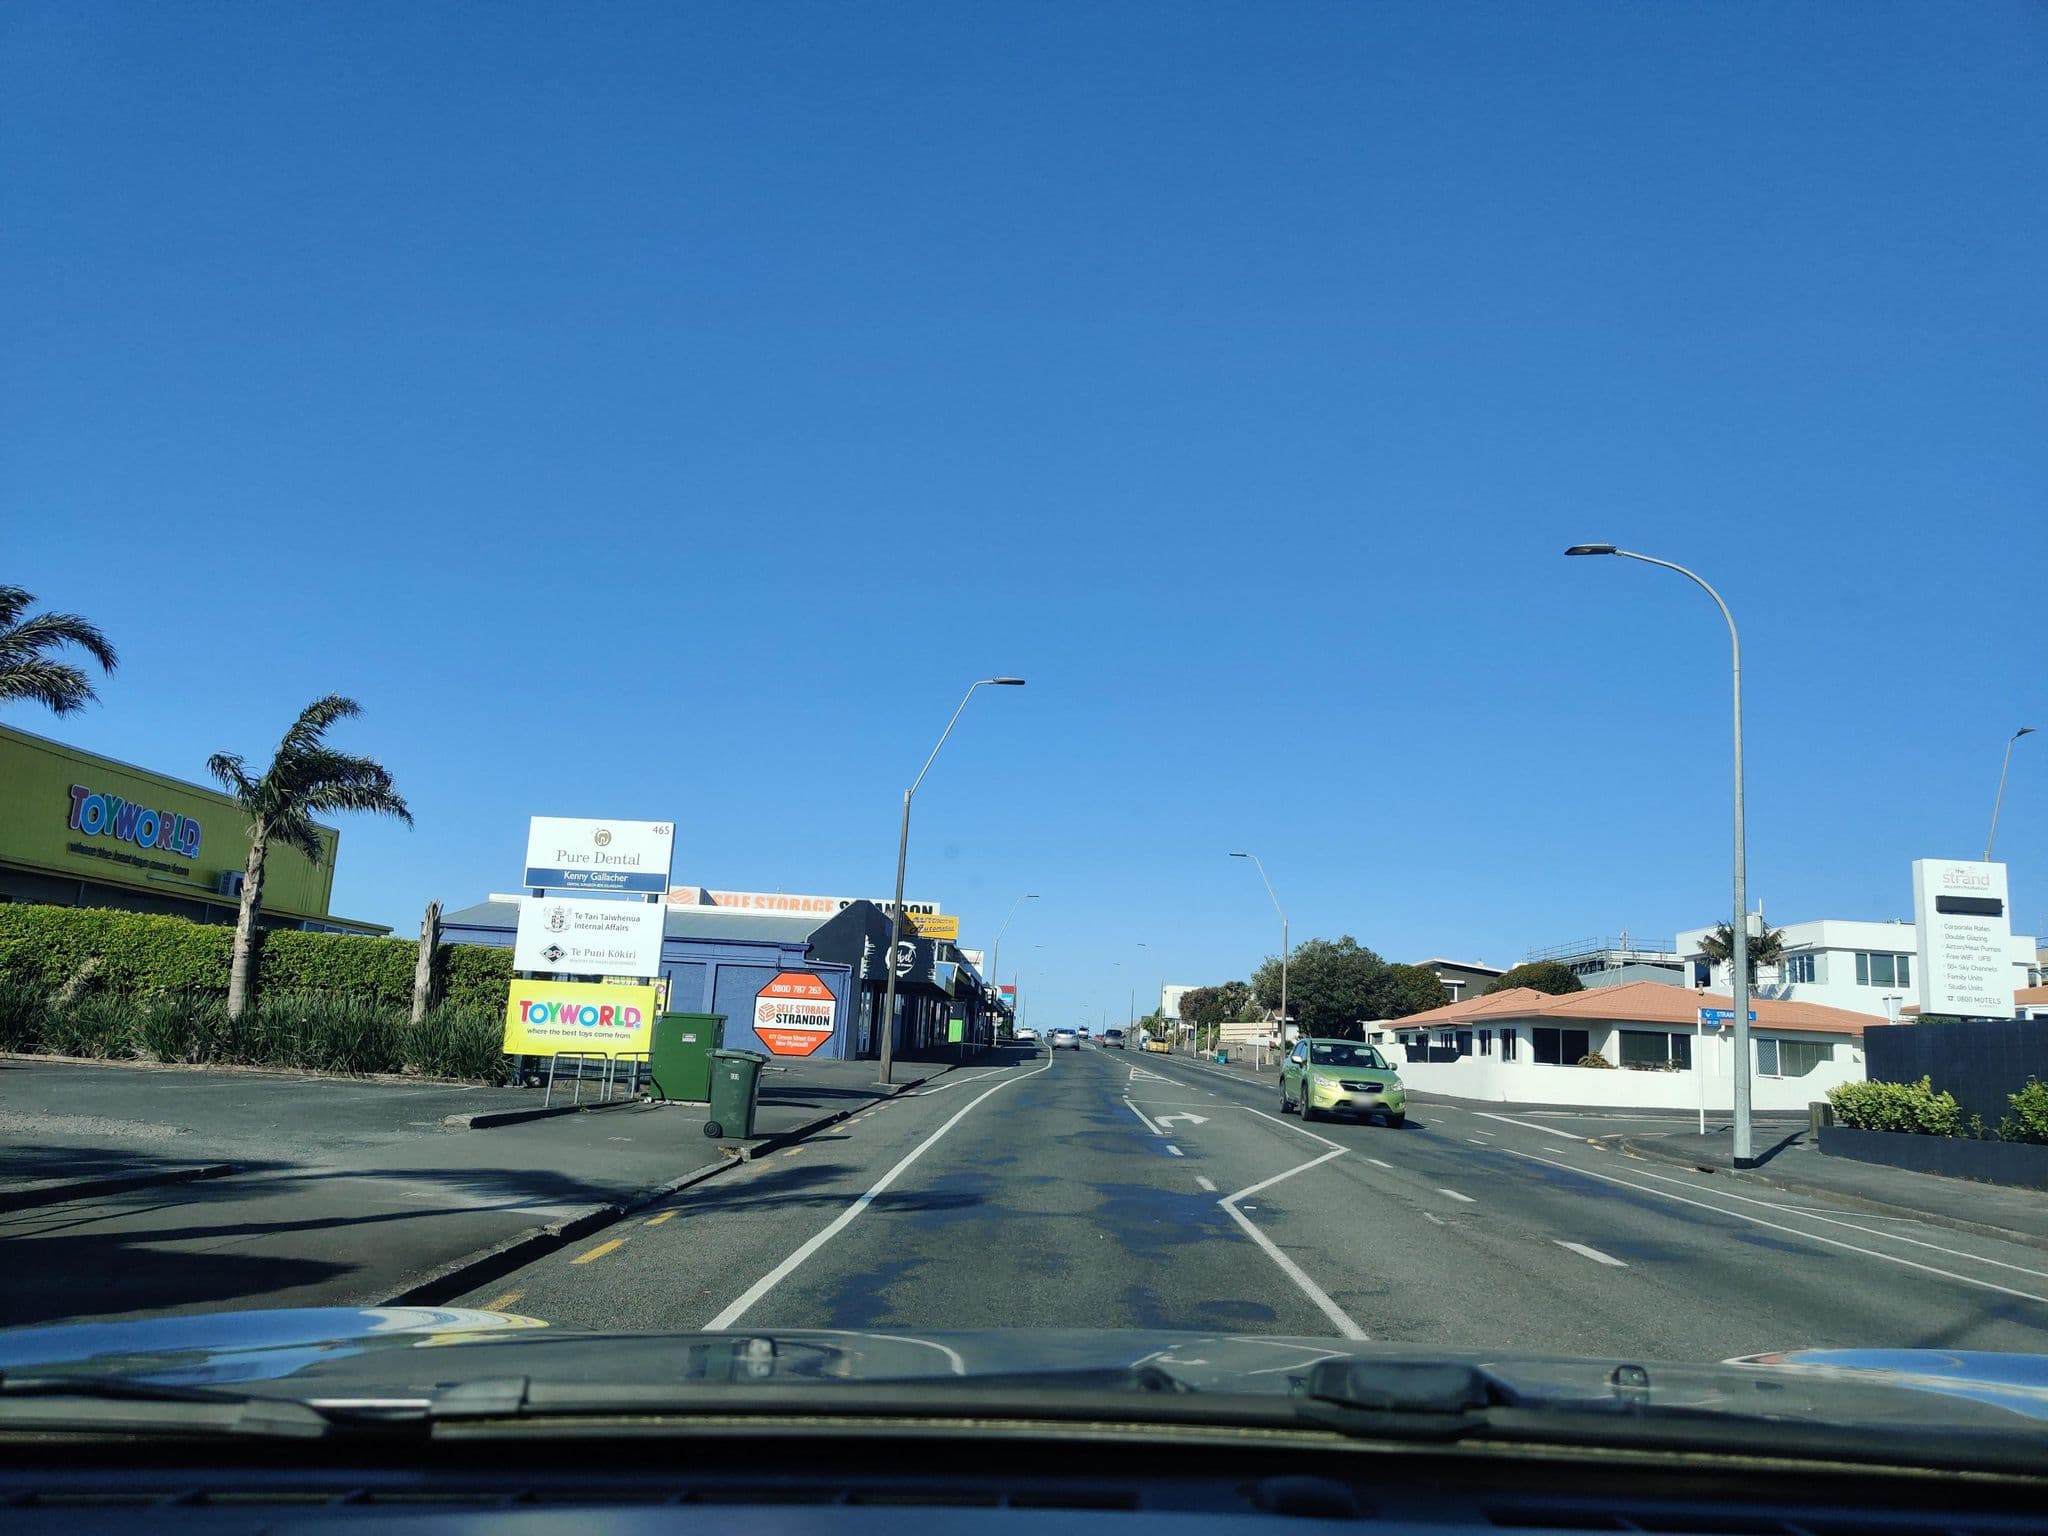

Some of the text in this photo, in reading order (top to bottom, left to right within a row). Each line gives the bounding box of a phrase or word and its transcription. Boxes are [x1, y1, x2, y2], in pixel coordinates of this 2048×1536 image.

[71, 784, 200, 857] TOYWORLD
[652, 825, 670, 835] 465
[556, 849, 641, 866] Pure Dental
[563, 870, 628, 883] Kenny Gallacher
[1942, 871, 1990, 886] strand
[574, 912, 583, 920] Te
[574, 922, 629, 932] Internal Affairs
[1944, 923, 1973, 931] Corporate
[572, 948, 581, 956] Te
[584, 948, 605, 957] Puni
[771, 984, 791, 992] 0800
[793, 985, 806, 994] 787
[1974, 996, 2001, 1004] MOTELS
[519, 1001, 641, 1028] TOYWORLD
[776, 1003, 831, 1016] SELF STORAGE
[775, 1013, 830, 1026] STRANDON
[527, 1027, 548, 1035] where
[578, 1030, 593, 1038] toys
